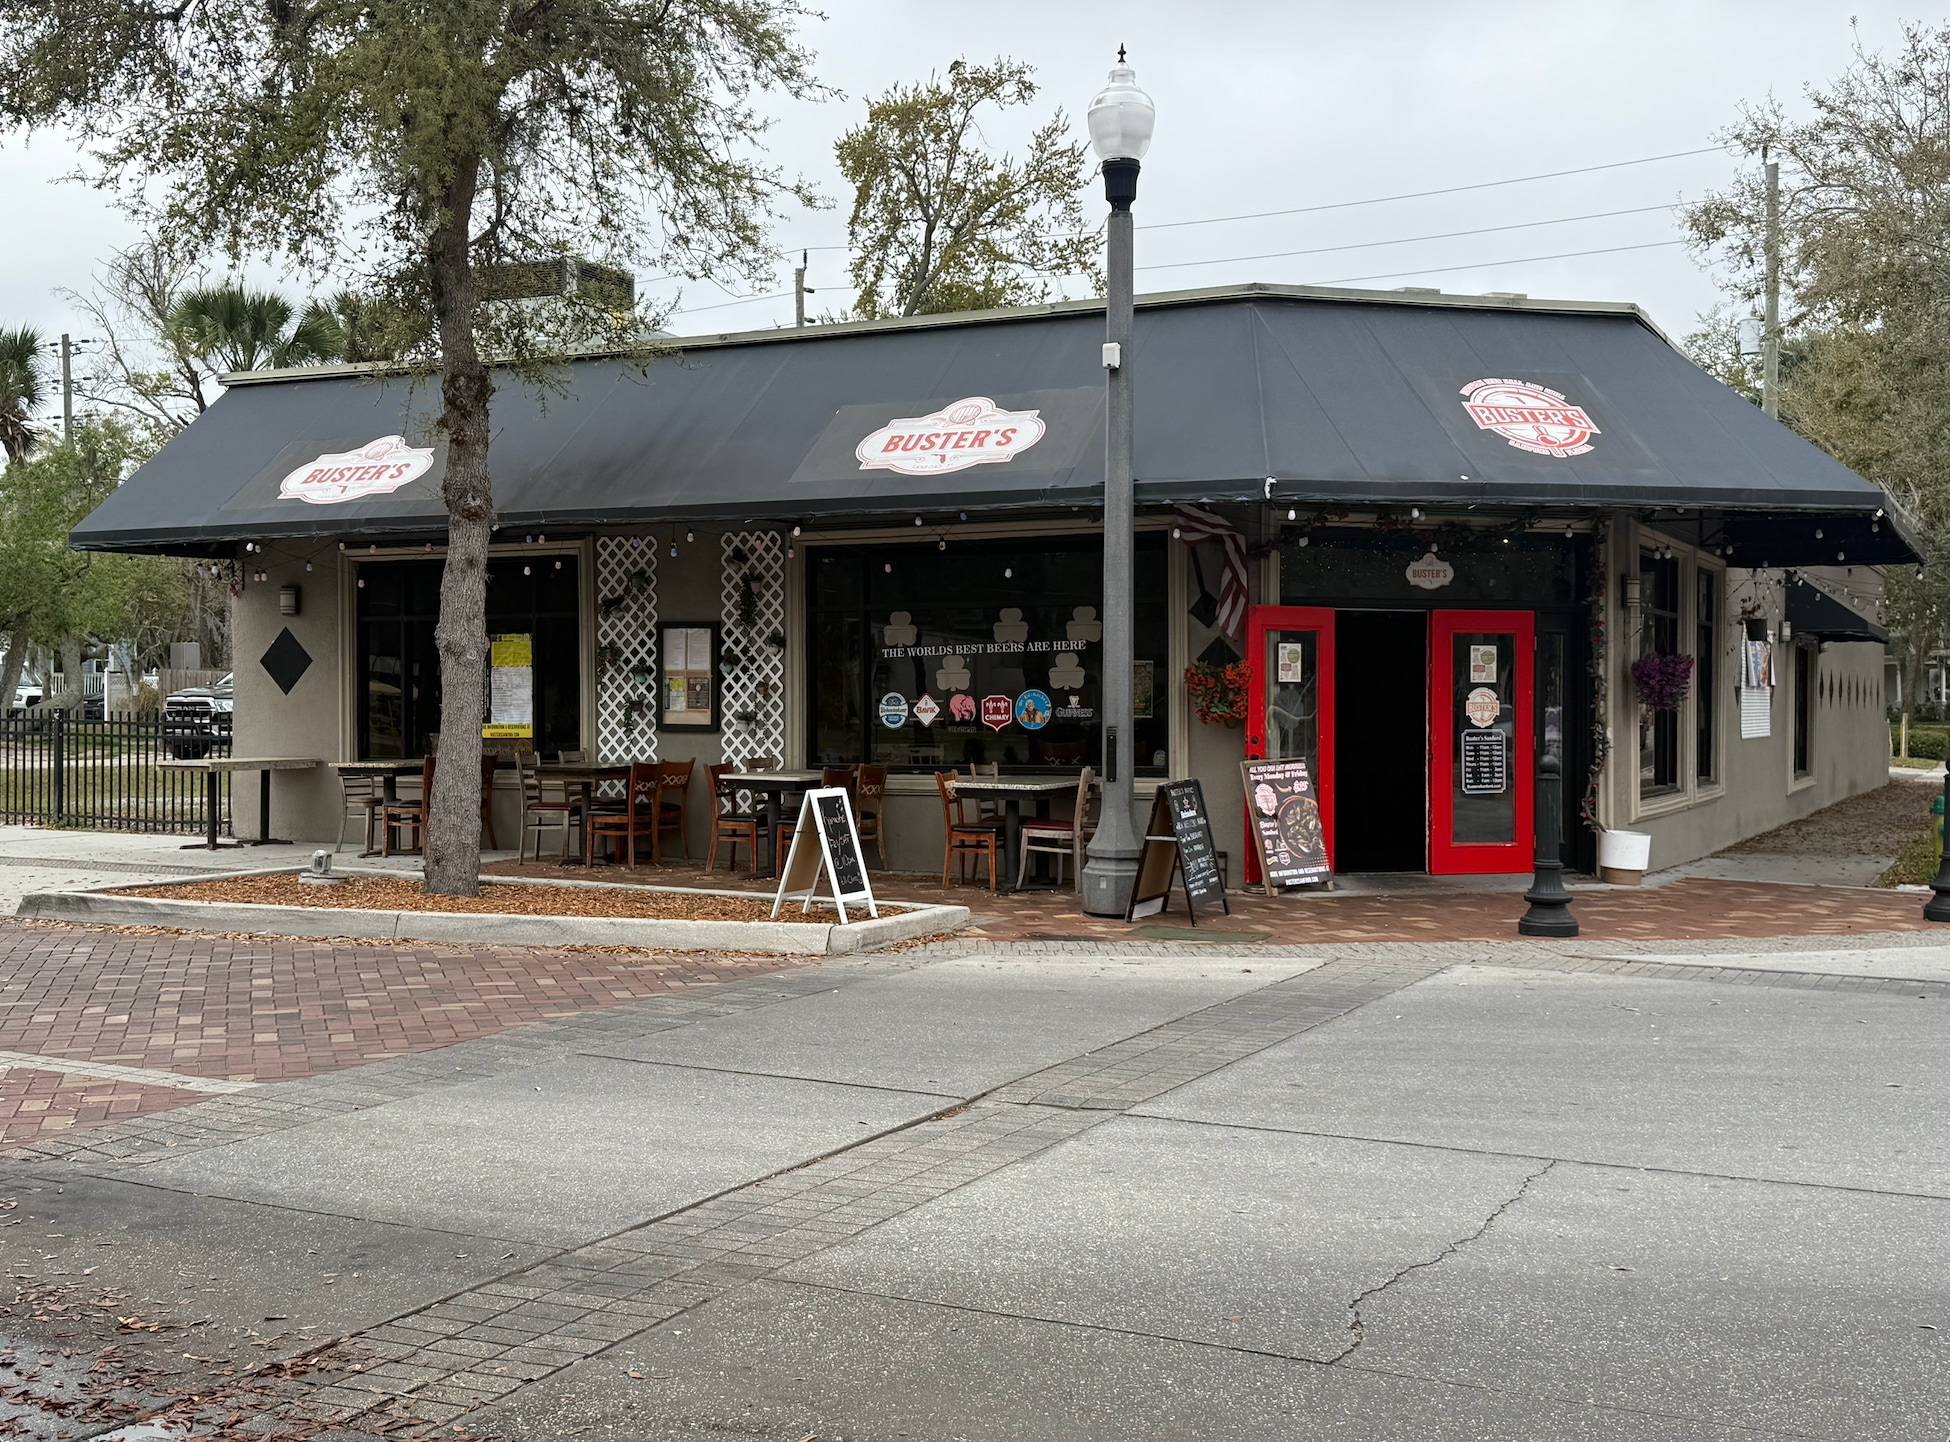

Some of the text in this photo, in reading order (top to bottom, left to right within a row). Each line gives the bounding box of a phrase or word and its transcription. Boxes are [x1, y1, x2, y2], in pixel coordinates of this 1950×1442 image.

[1474, 406, 1587, 428] BUSTER'S
[881, 428, 1018, 453] BUSTER'S
[300, 463, 411, 485] BUSTER'S
[1412, 568, 1448, 578] BUSTER'S
[882, 640, 1087, 658] THE WORLDS BEST BEERS ARE HERE
[1055, 707, 1094, 718] GUINNESS
[1264, 772, 1284, 780] Monday
